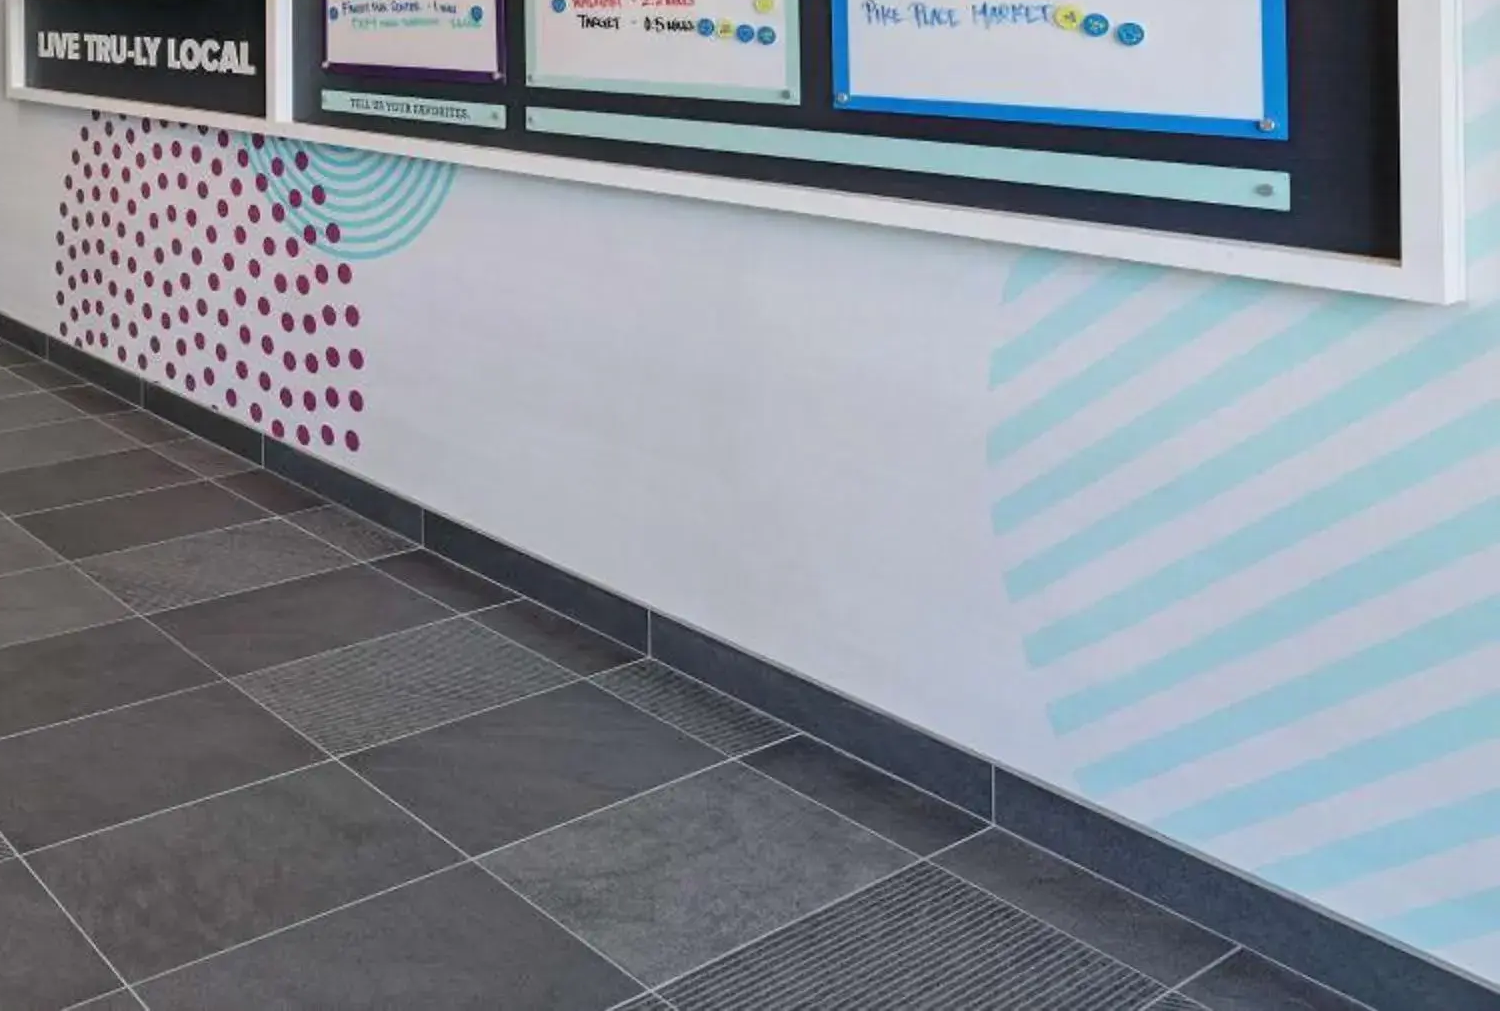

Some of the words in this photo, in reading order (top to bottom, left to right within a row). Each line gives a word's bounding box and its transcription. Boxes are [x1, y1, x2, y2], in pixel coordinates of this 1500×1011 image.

[576, 14, 620, 29] TARGET
[37, 31, 81, 60] LIVE
[83, 33, 162, 68] TRU-LY
[166, 38, 256, 76] LOCAL
